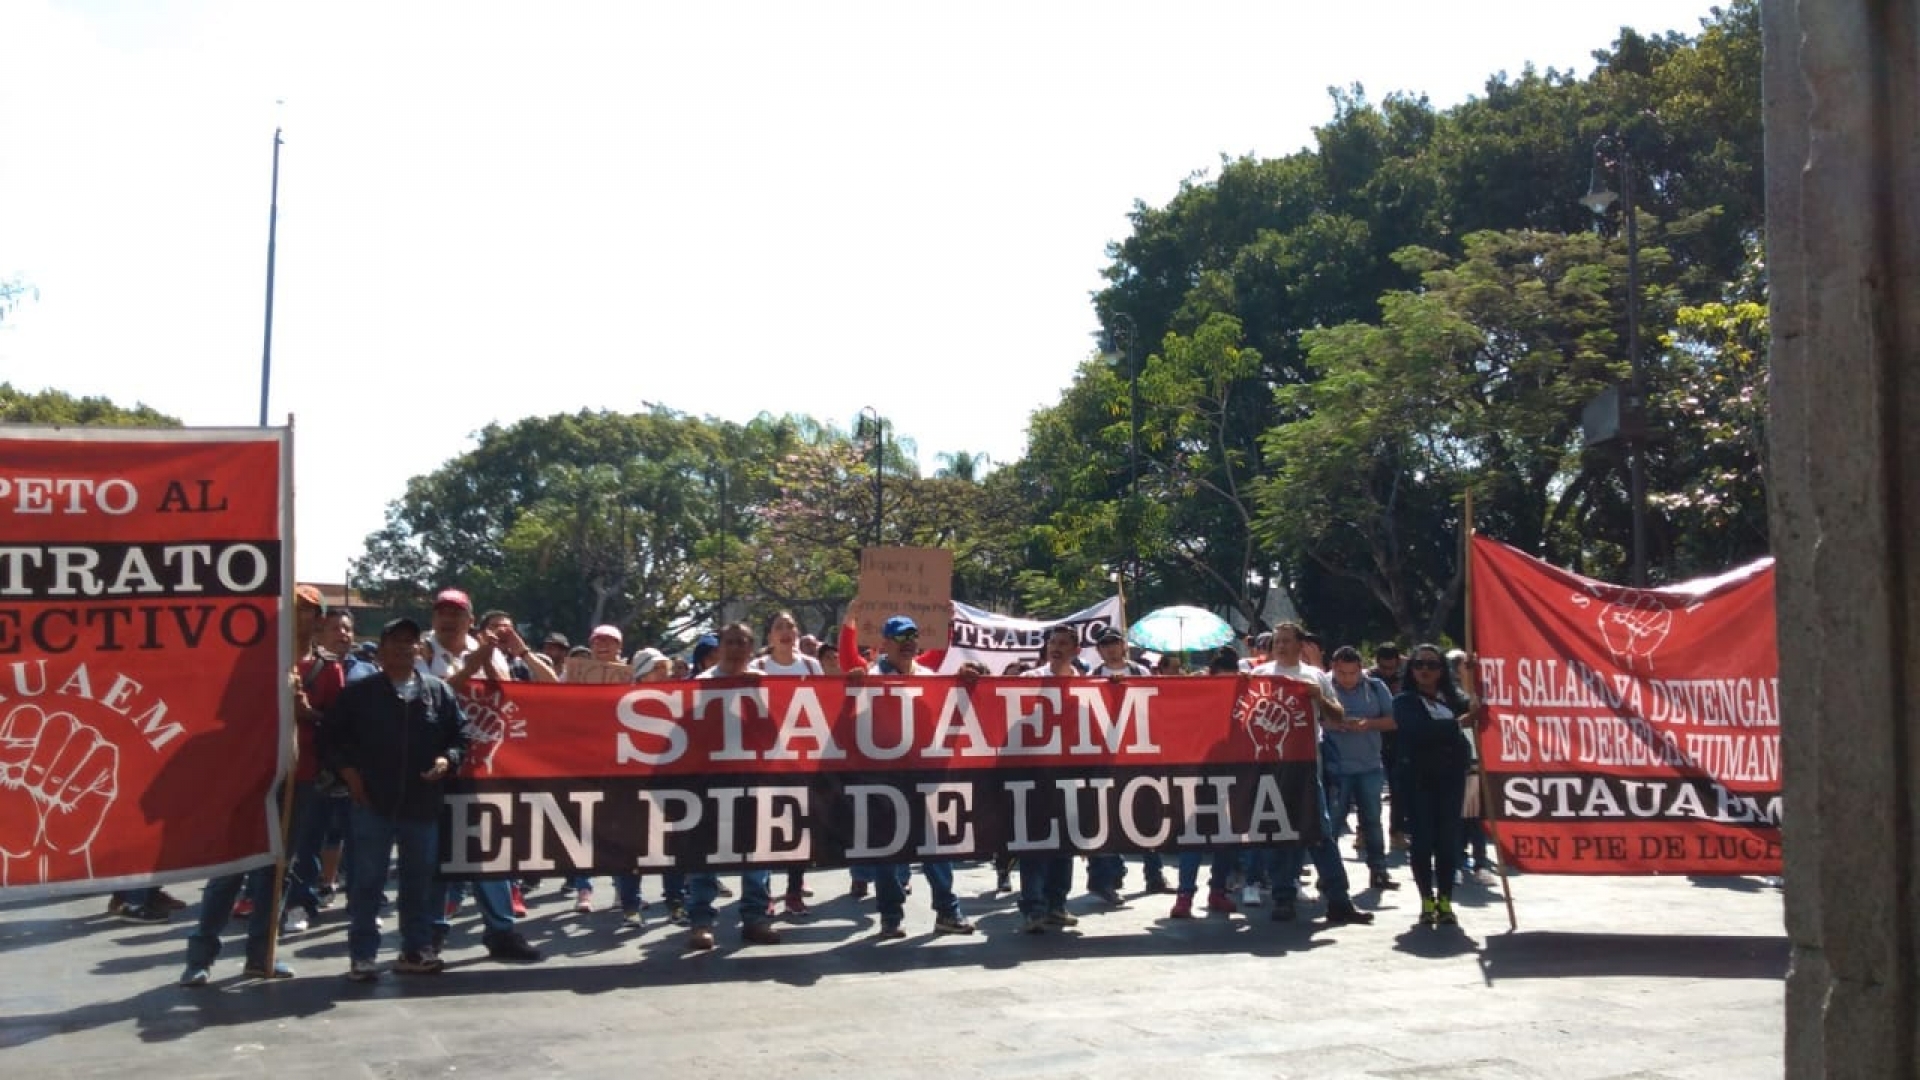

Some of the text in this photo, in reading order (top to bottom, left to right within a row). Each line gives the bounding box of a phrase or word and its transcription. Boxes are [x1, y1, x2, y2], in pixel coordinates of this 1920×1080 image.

[156, 480, 228, 512] AL
[0, 543, 269, 597] TRATO
[0, 659, 188, 753] UAEM
[1479, 658, 1513, 706] EL
[615, 686, 1161, 766] STAUAEM
[1498, 713, 1532, 763] ES
[1536, 716, 1572, 763] UN
[440, 773, 1300, 874] EN PIE DE LUCHA
[1512, 835, 1560, 860] EN
[1571, 835, 1627, 861] PIE
[1639, 836, 1686, 861] DE
